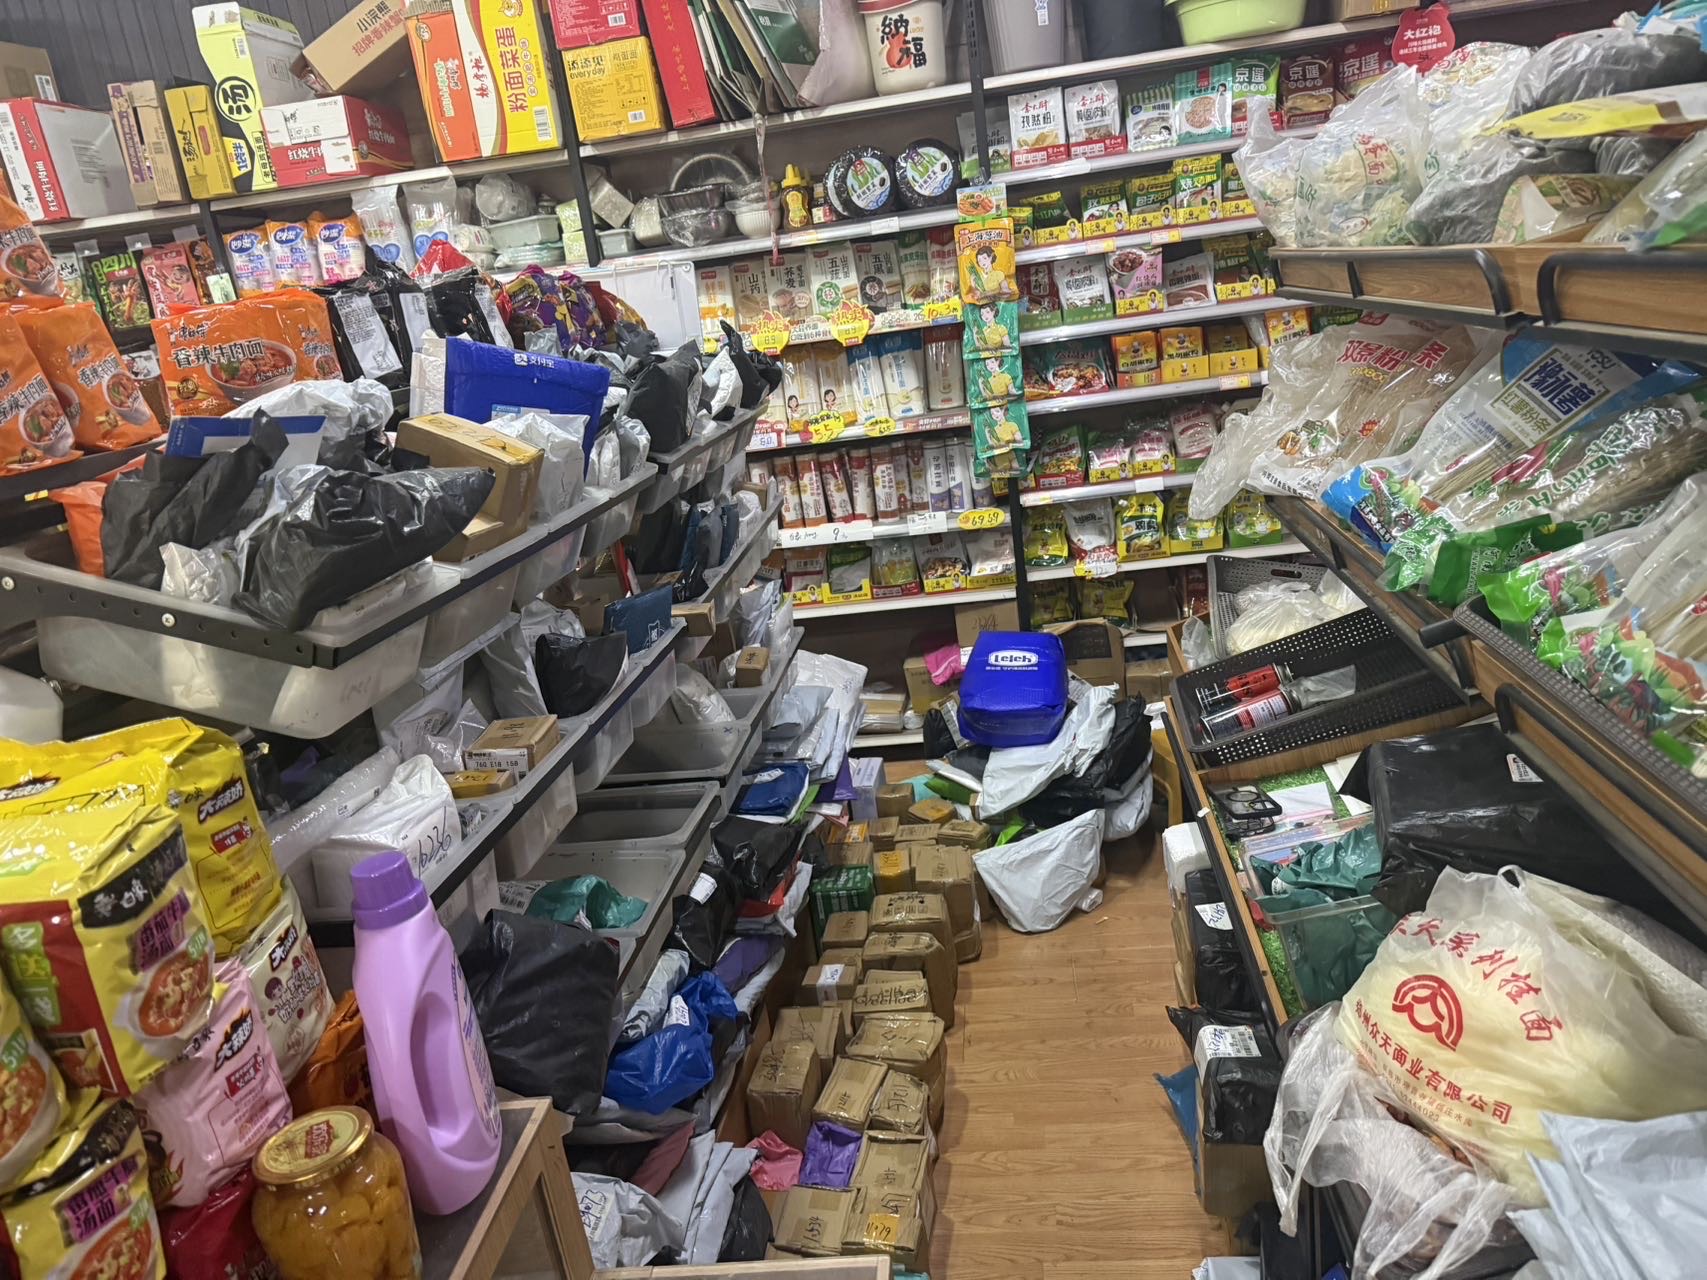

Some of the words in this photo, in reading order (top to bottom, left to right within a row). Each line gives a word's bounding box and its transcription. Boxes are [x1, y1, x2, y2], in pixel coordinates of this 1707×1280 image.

[355, 2, 391, 33] 小浣熊
[1403, 25, 1442, 41] 大红袍
[494, 26, 530, 114] 粉面菜蛋
[222, 83, 254, 117] 汤
[172, 339, 265, 369] 香辣牛肉面
[1500, 390, 1552, 434] 红薯粉条
[1354, 998, 1514, 1125] 郑州众天面业有限公司
